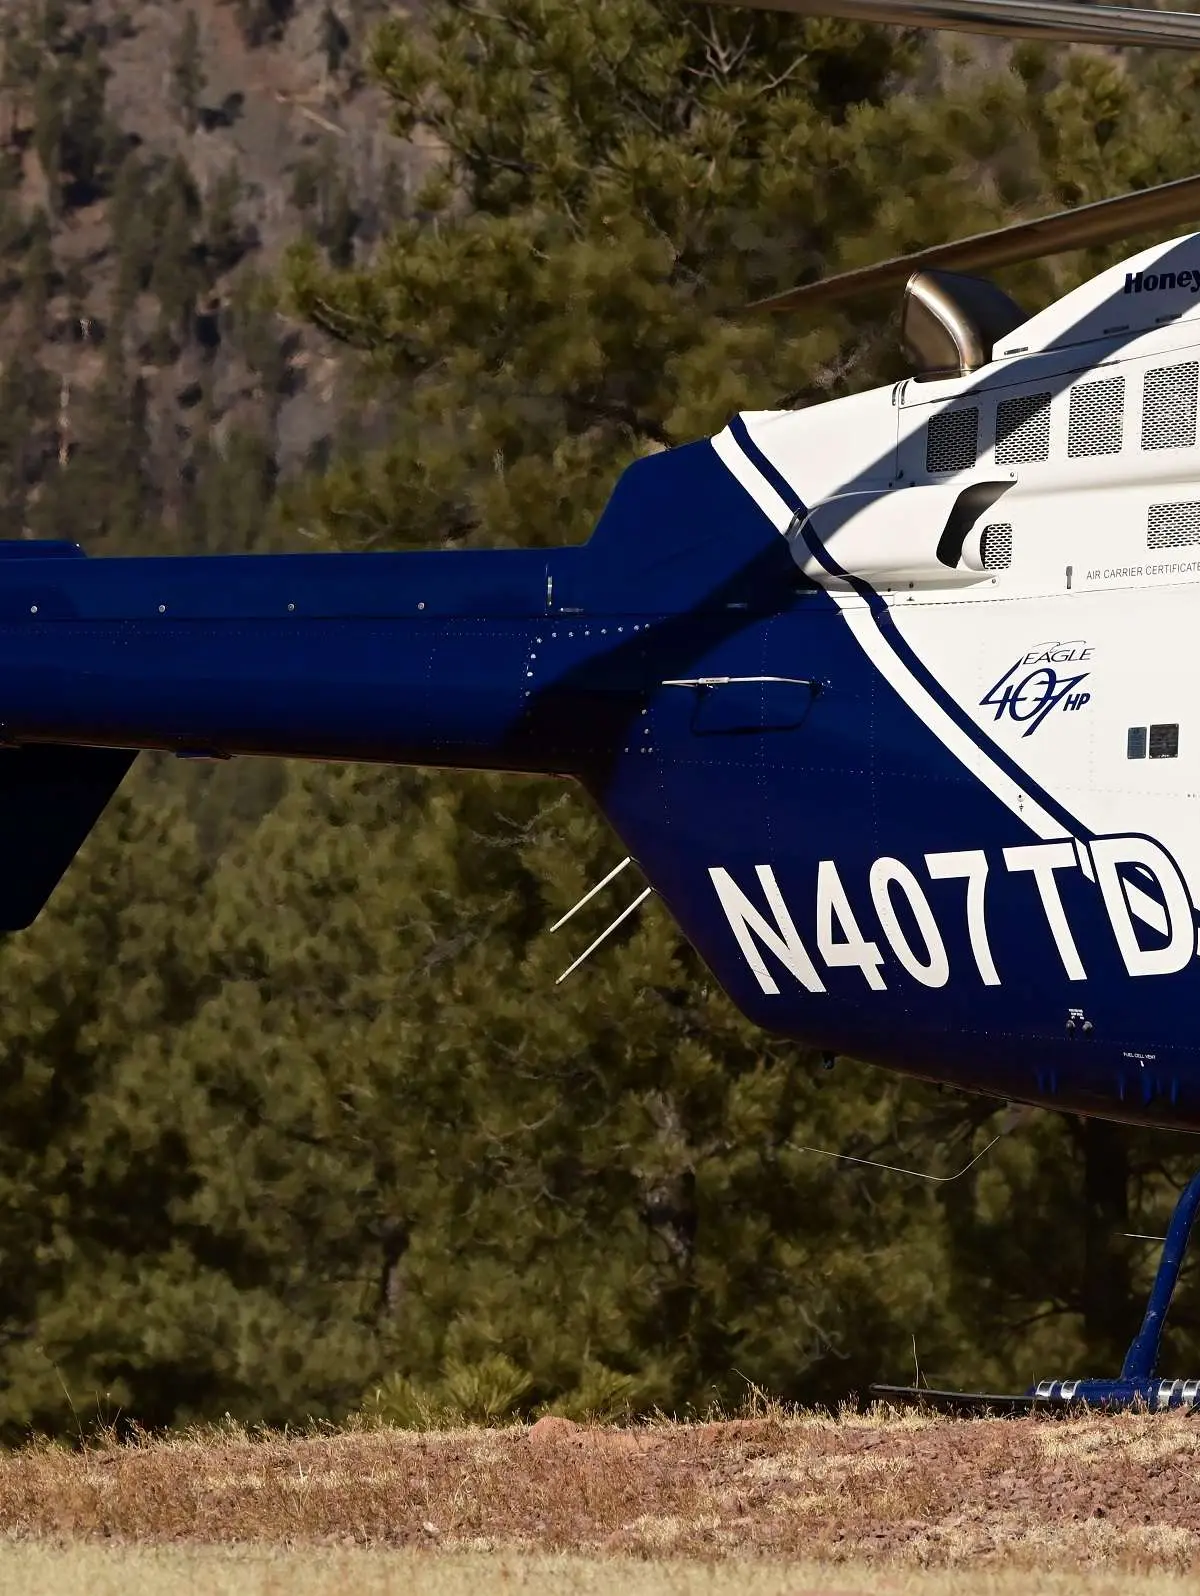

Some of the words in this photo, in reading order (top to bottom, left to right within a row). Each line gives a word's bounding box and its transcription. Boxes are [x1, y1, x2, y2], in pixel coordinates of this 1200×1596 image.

[1086, 570, 1101, 580] AIR
[1103, 566, 1143, 579] CARRIER
[1022, 647, 1095, 665] EAGLE
[979, 655, 1091, 738] 407
[1063, 692, 1091, 711] HP
[708, 836, 1196, 995] N407TD
